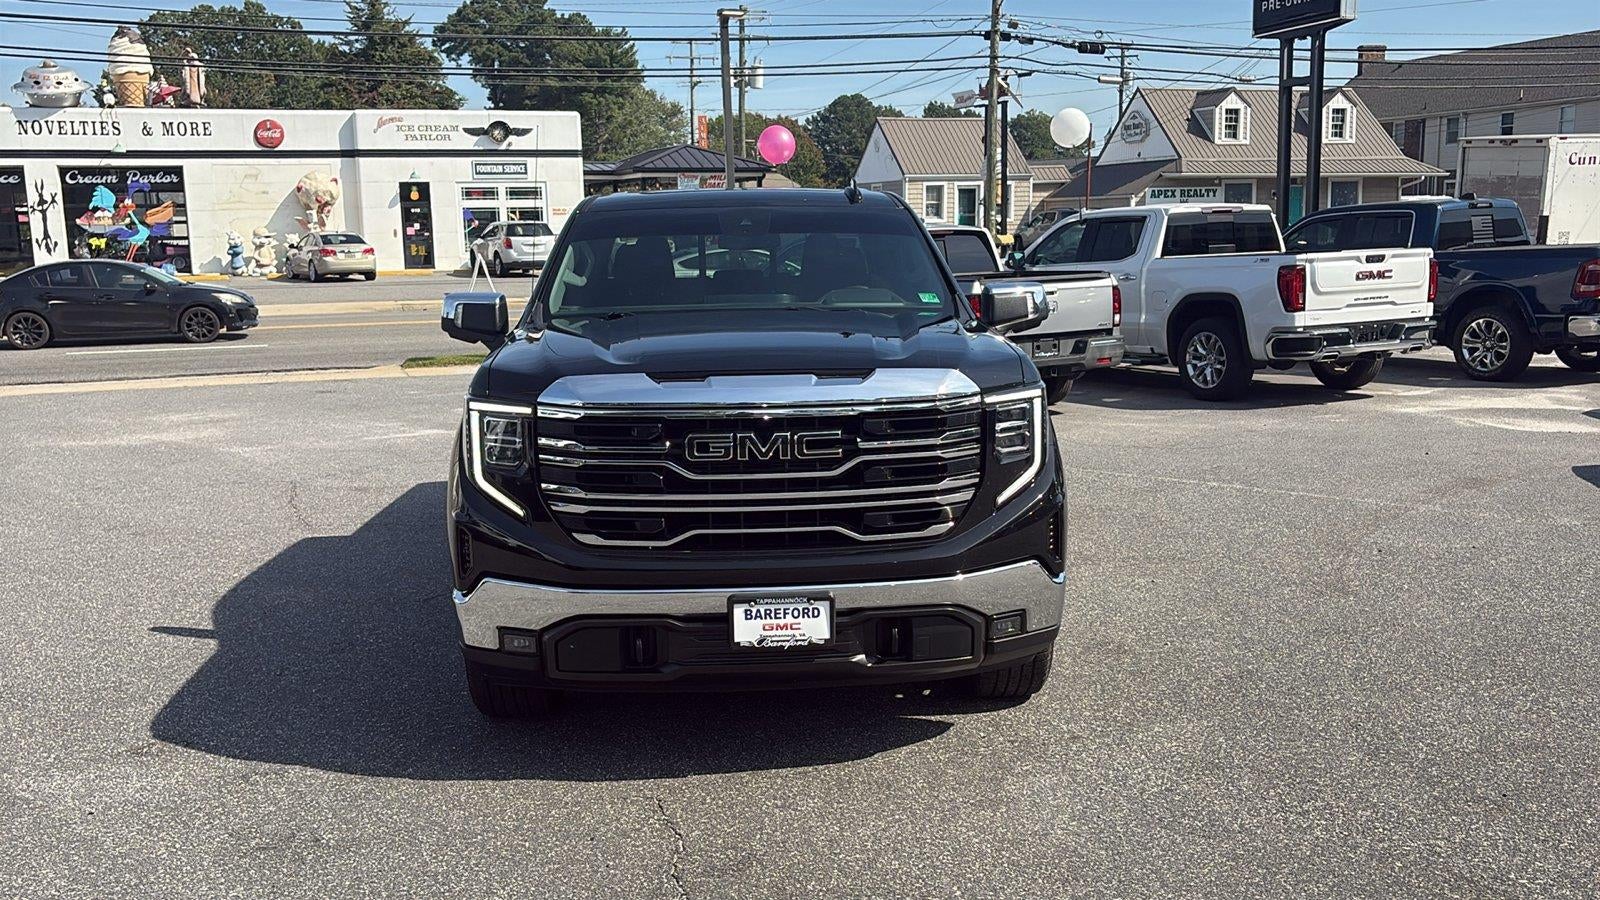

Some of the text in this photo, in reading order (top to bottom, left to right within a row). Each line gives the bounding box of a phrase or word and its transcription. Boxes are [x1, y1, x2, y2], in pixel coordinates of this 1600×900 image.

[16, 119, 213, 137] NOVELTIES & MORE
[1568, 151, 1600, 166] Cun
[476, 164, 526, 173] FOUNTAIN SERVICE
[65, 170, 180, 184] Cream Parlor
[1150, 188, 1218, 198] APEX REALTY
[1355, 269, 1393, 281] GMC
[685, 430, 843, 462] GMC
[744, 607, 820, 620] BAREFORD
[762, 622, 801, 631] GMC
[754, 636, 812, 650] Bareford
